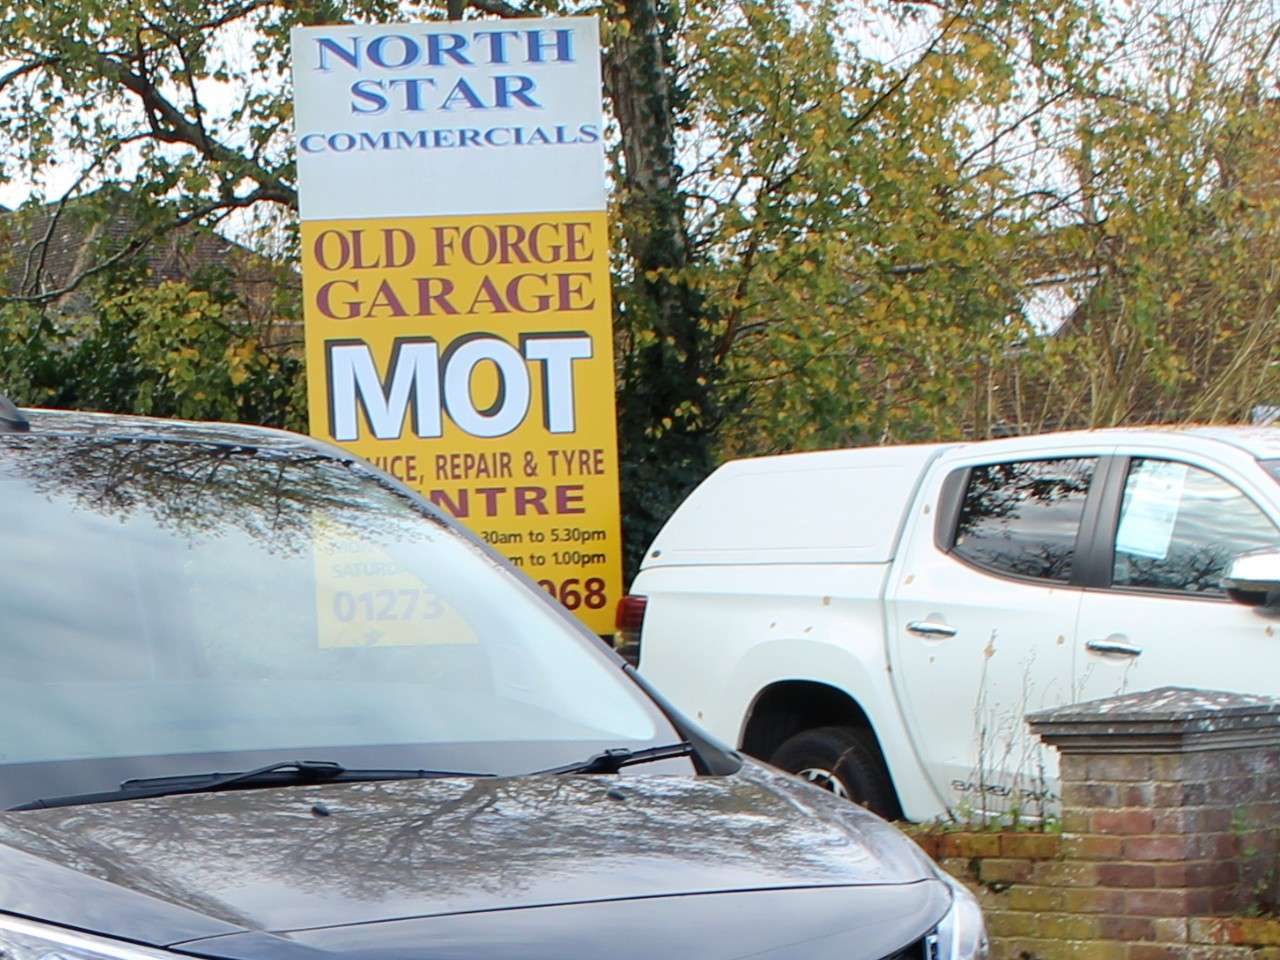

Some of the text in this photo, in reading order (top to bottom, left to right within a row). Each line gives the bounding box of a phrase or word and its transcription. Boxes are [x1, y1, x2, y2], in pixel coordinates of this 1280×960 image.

[313, 28, 576, 72] NORTH
[350, 74, 543, 115] STAR
[299, 124, 600, 153] COMMERCIALS
[313, 222, 595, 271] OLD FORGE
[315, 272, 596, 320] GARAGE
[324, 330, 594, 441] MOT
[435, 452, 513, 481] REPAIR
[523, 450, 539, 478] &
[548, 448, 605, 477] TYRE
[418, 484, 587, 518] NTRE
[529, 531, 545, 544] to
[551, 528, 607, 545] 5.30pm
[530, 553, 546, 566] to
[554, 551, 607, 568] 1.00pm
[332, 588, 447, 623] 01273
